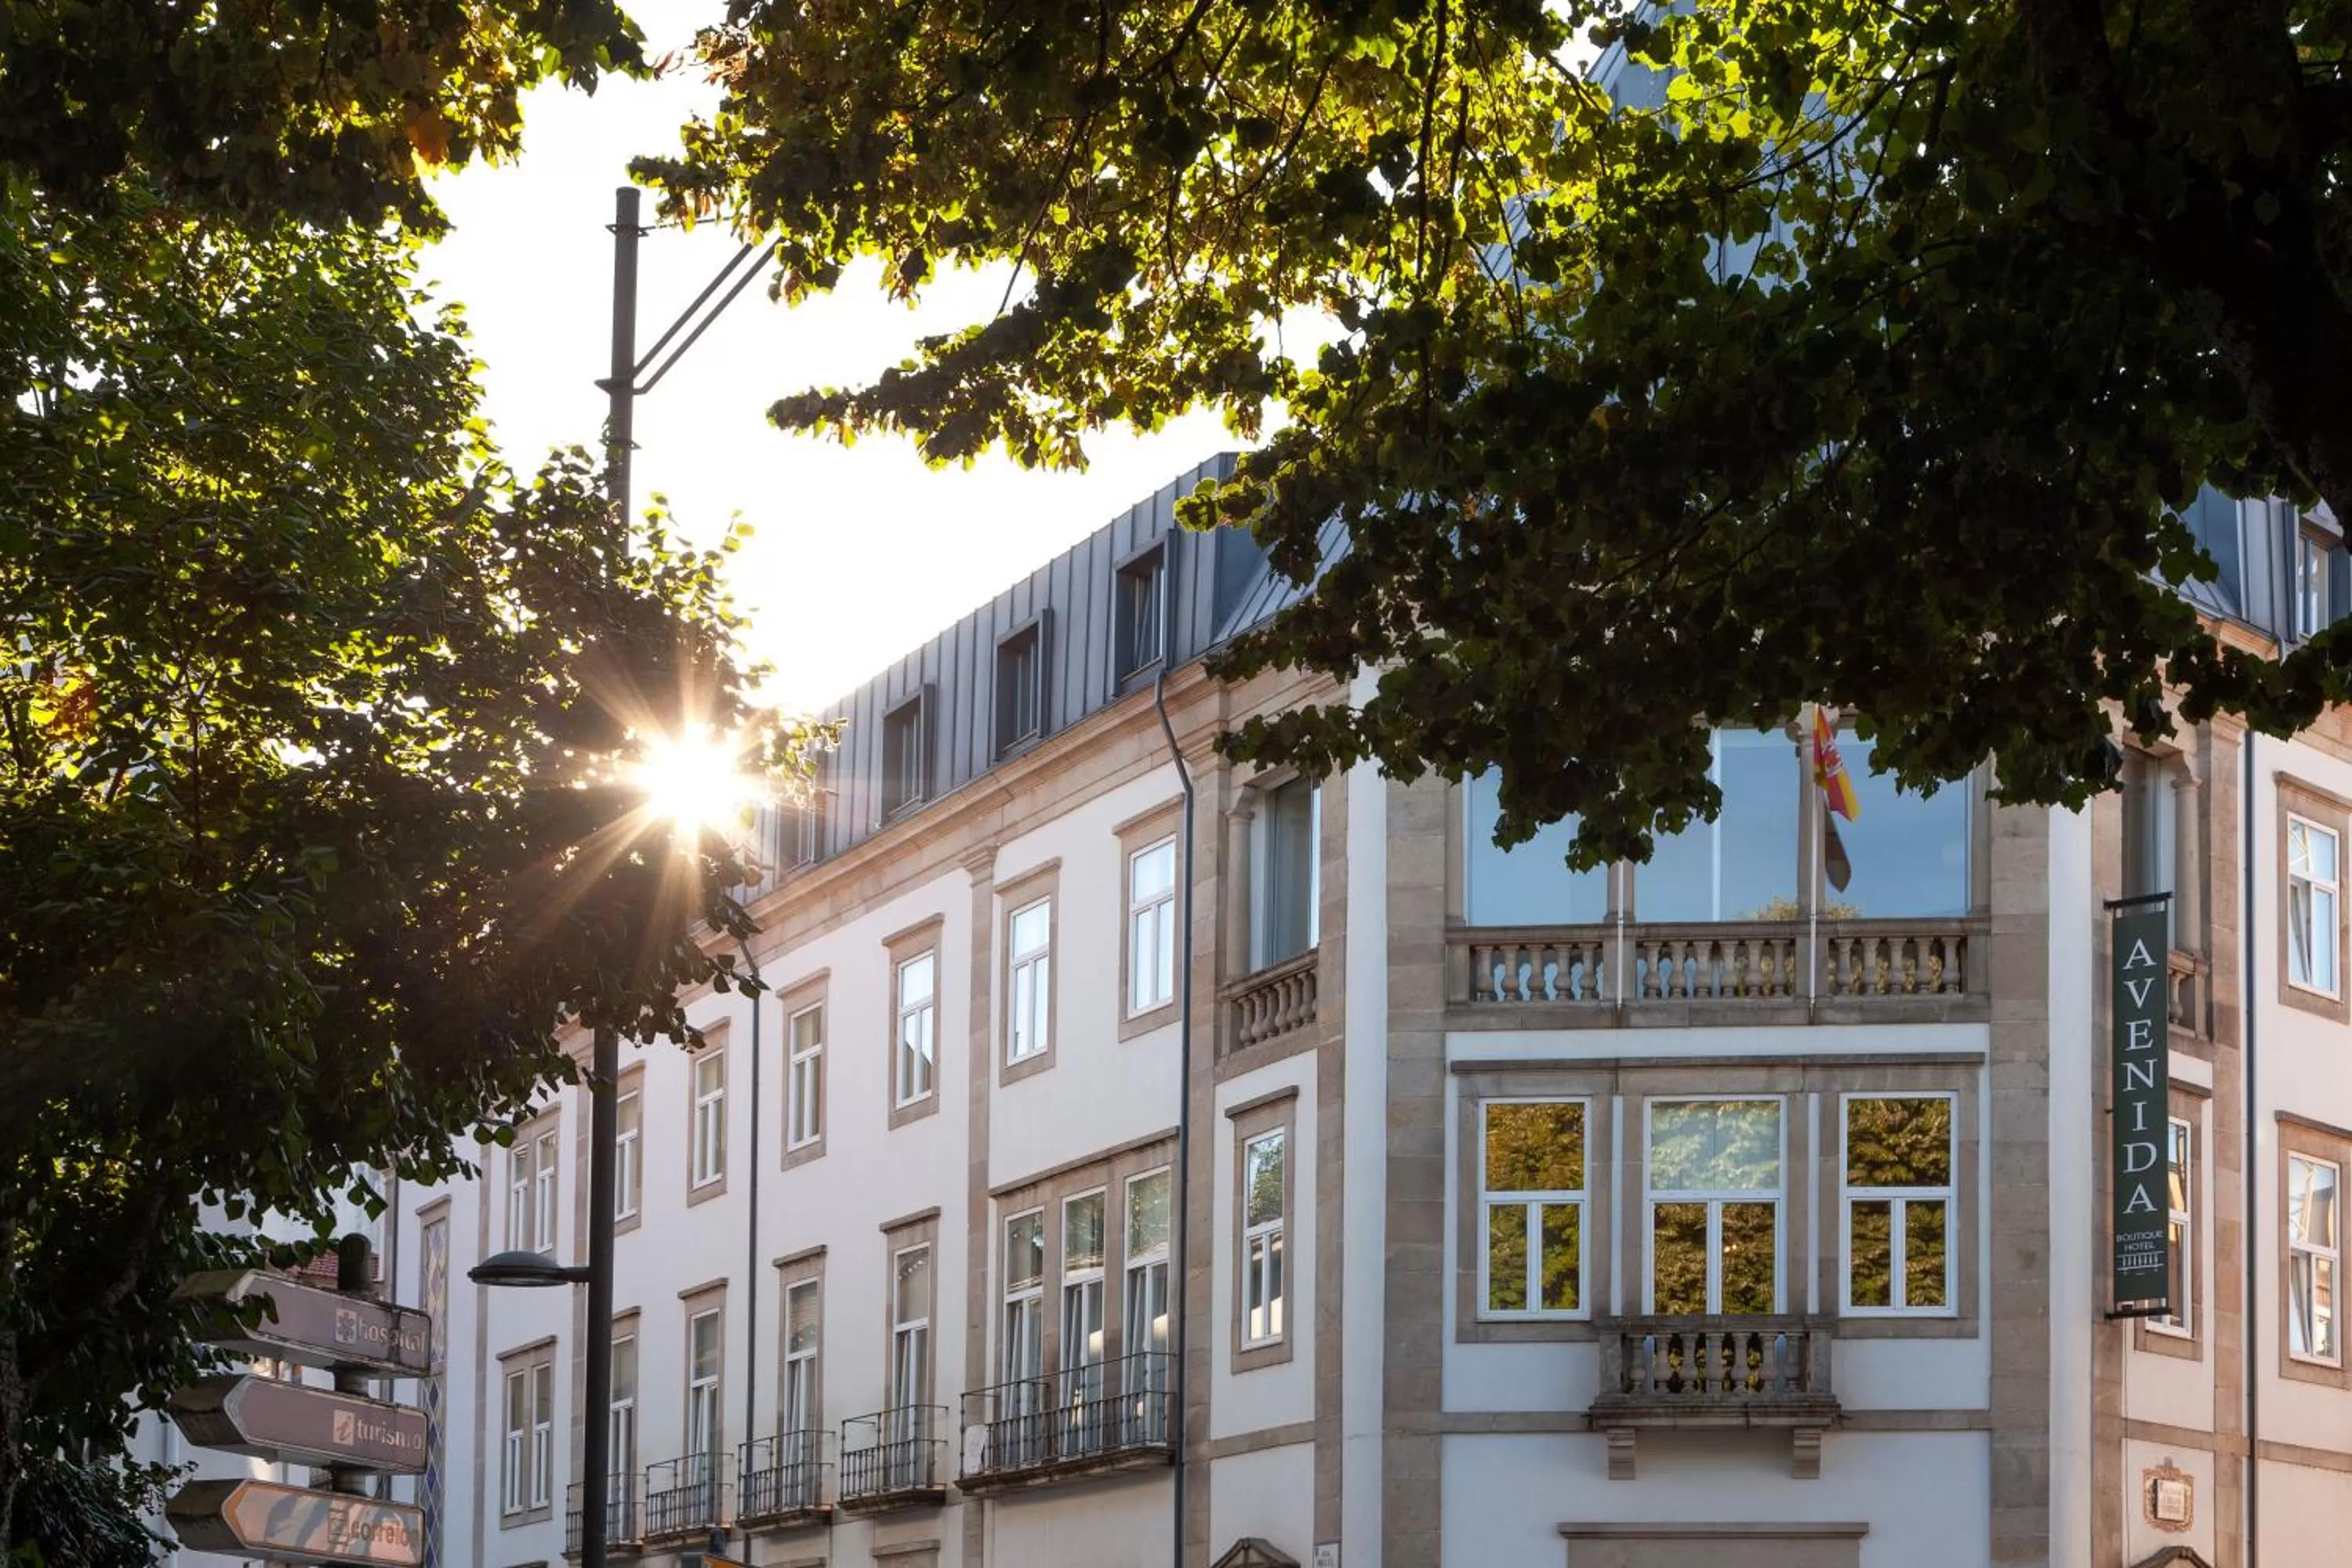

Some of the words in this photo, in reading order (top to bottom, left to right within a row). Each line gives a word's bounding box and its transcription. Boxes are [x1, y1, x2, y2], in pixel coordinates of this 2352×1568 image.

[2122, 937, 2158, 1214] AVENIDA
[2117, 1229, 2165, 1242] BOUTIQUE
[2123, 1241, 2156, 1251] HOTEL
[357, 1419, 423, 1450] turismo
